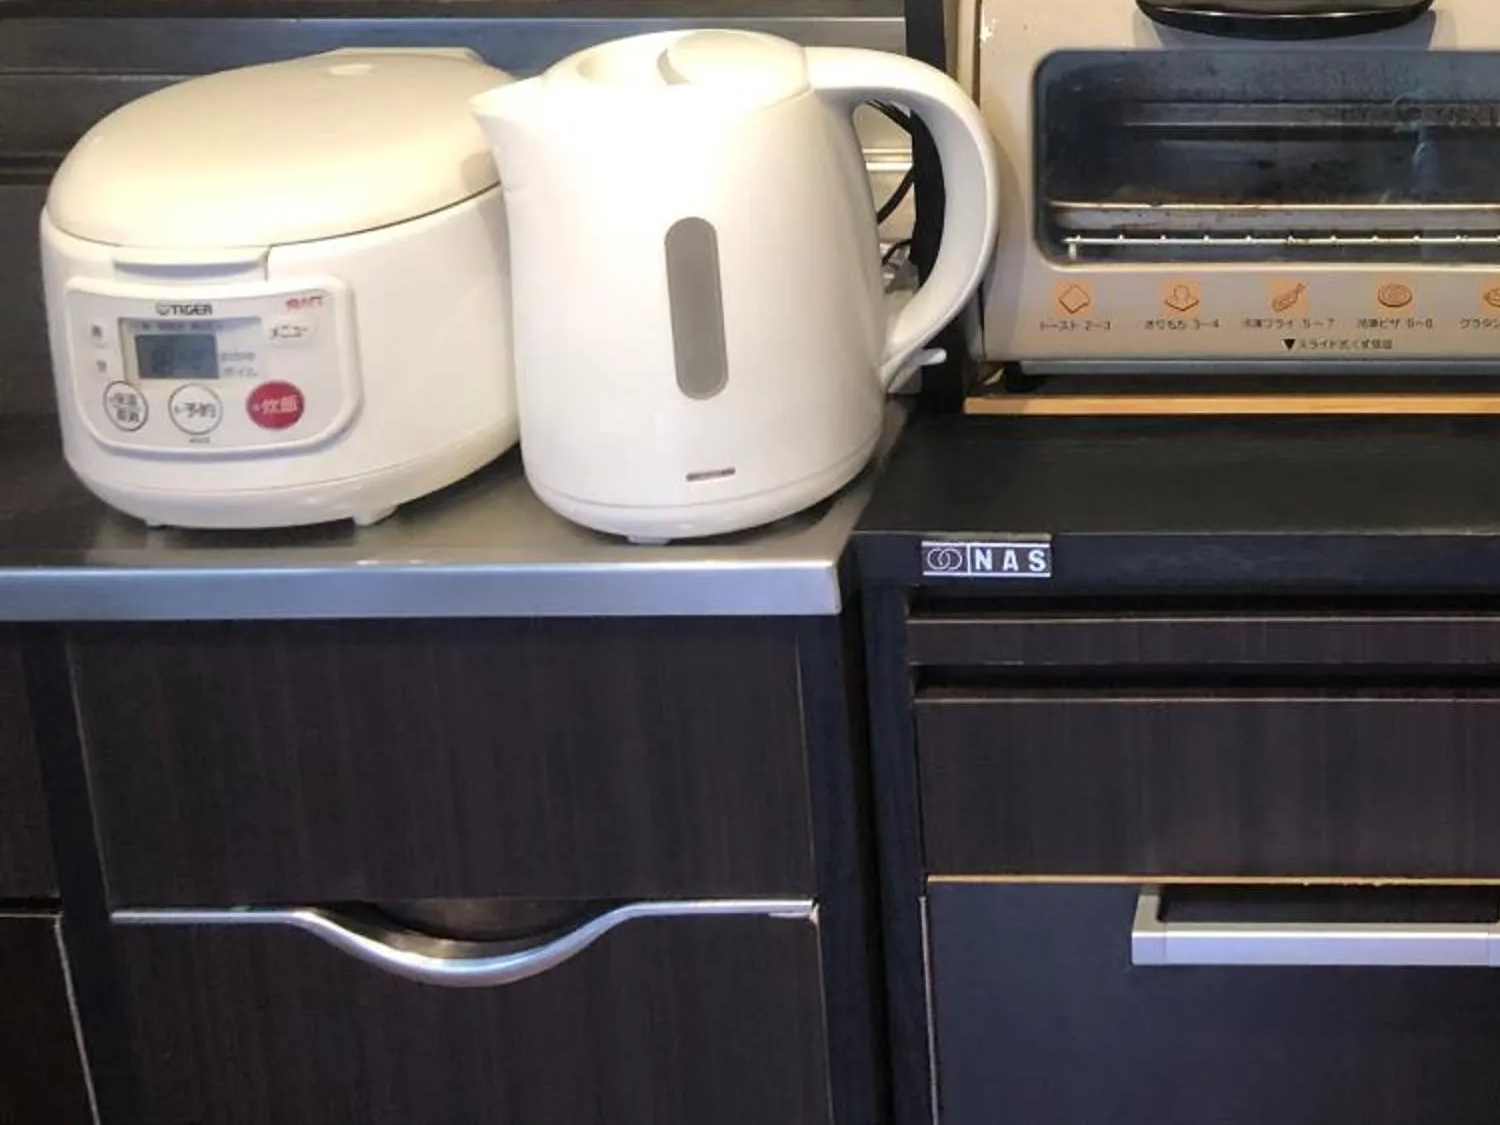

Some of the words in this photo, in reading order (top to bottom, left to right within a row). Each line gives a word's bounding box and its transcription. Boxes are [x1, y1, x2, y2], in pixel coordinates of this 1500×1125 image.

[170, 303, 212, 315] TIGER
[261, 394, 298, 414] 炊飯
[975, 548, 1047, 572] NAS
